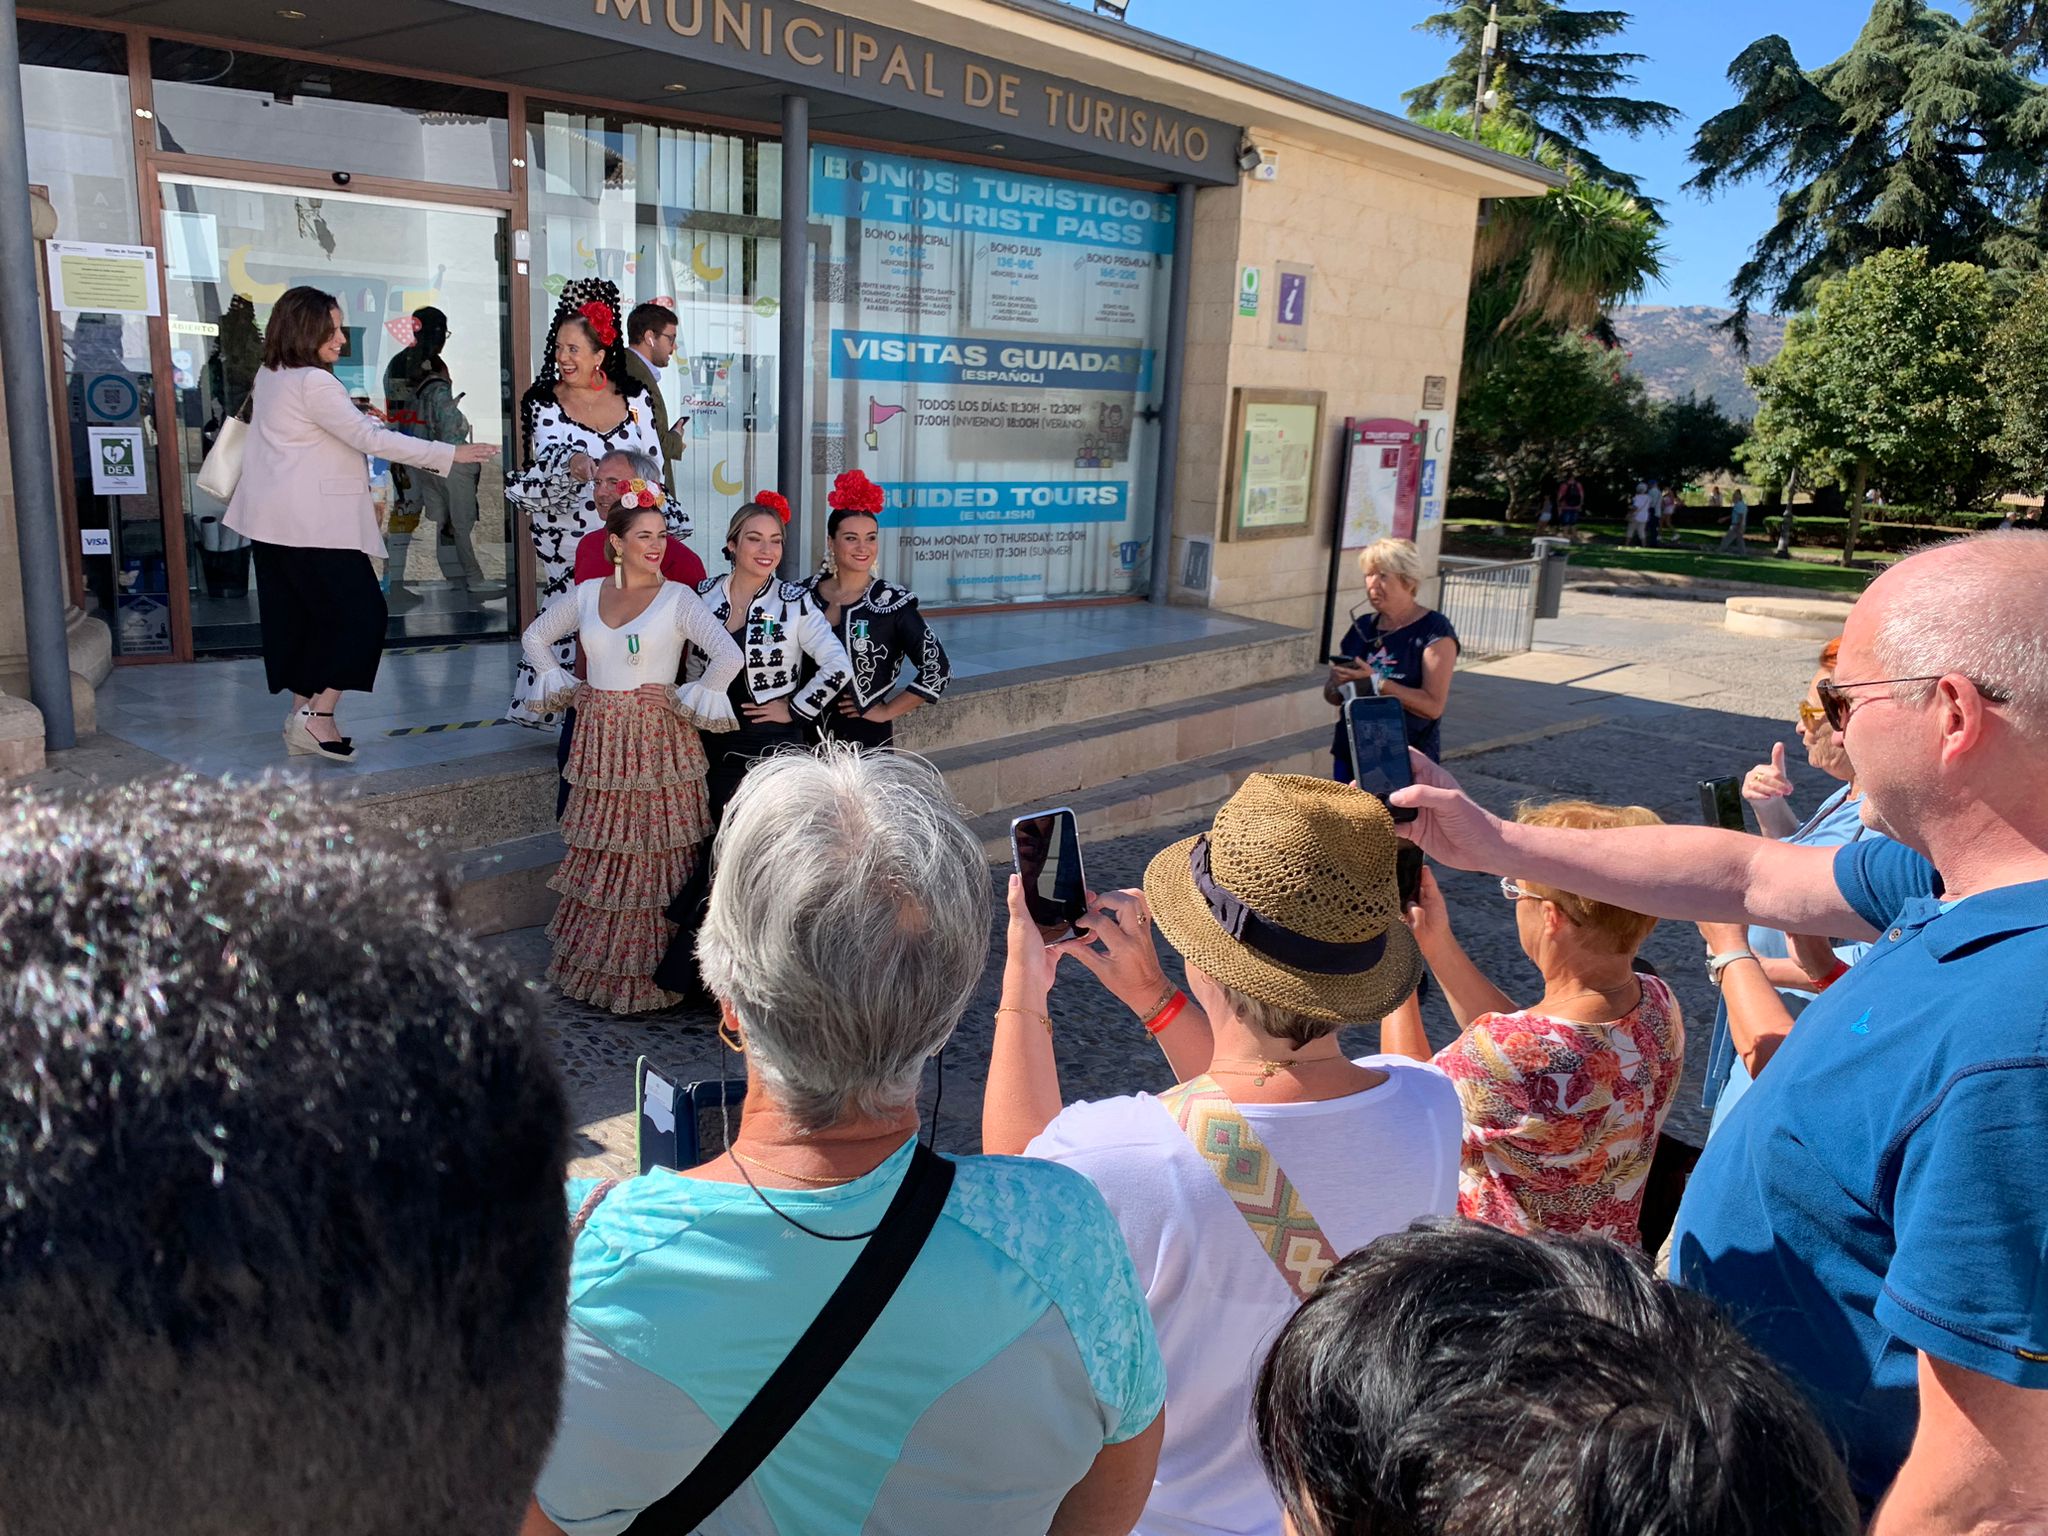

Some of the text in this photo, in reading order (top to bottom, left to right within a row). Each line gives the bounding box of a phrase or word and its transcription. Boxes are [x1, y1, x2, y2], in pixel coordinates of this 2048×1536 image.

[594, 0, 1210, 162] MUNICIPAL DE TURISMO
[823, 155, 1172, 224] BONOS TURÍSTICOS
[885, 193, 1045, 233] TOURIST
[1056, 215, 1143, 246] PASS
[864, 228, 950, 247] BONO MUNICIPAL
[990, 242, 1042, 257] BONO PLUS
[1086, 253, 1151, 268] BONO PREMIUM
[172, 322, 215, 333] ABIERTO
[843, 337, 988, 367] VISITAS
[961, 369, 1044, 384] (ESPAÑOL)
[681, 395, 726, 407] Ronda
[917, 399, 955, 412] TODOS
[958, 400, 980, 412] LOS
[981, 398, 1008, 413] DÍAS:
[1011, 402, 1040, 414] 11:30H
[1050, 403, 1082, 415] 12:30H
[914, 415, 1086, 430] 17:00H (INVIERNO) 18:00H (VERANO)
[107, 465, 131, 475] DEA
[1010, 485, 1119, 507] TOURS
[959, 509, 1035, 522] (ENGLISH)
[86, 538, 109, 547] VISA
[899, 530, 1087, 548] FROM MONDAY TO THURSDAY: 12:00H
[915, 550, 949, 562] 16:30H
[951, 548, 994, 561] (WINTER)
[995, 547, 1027, 559] 17:30H
[946, 573, 1042, 587] turismoderonda.es
